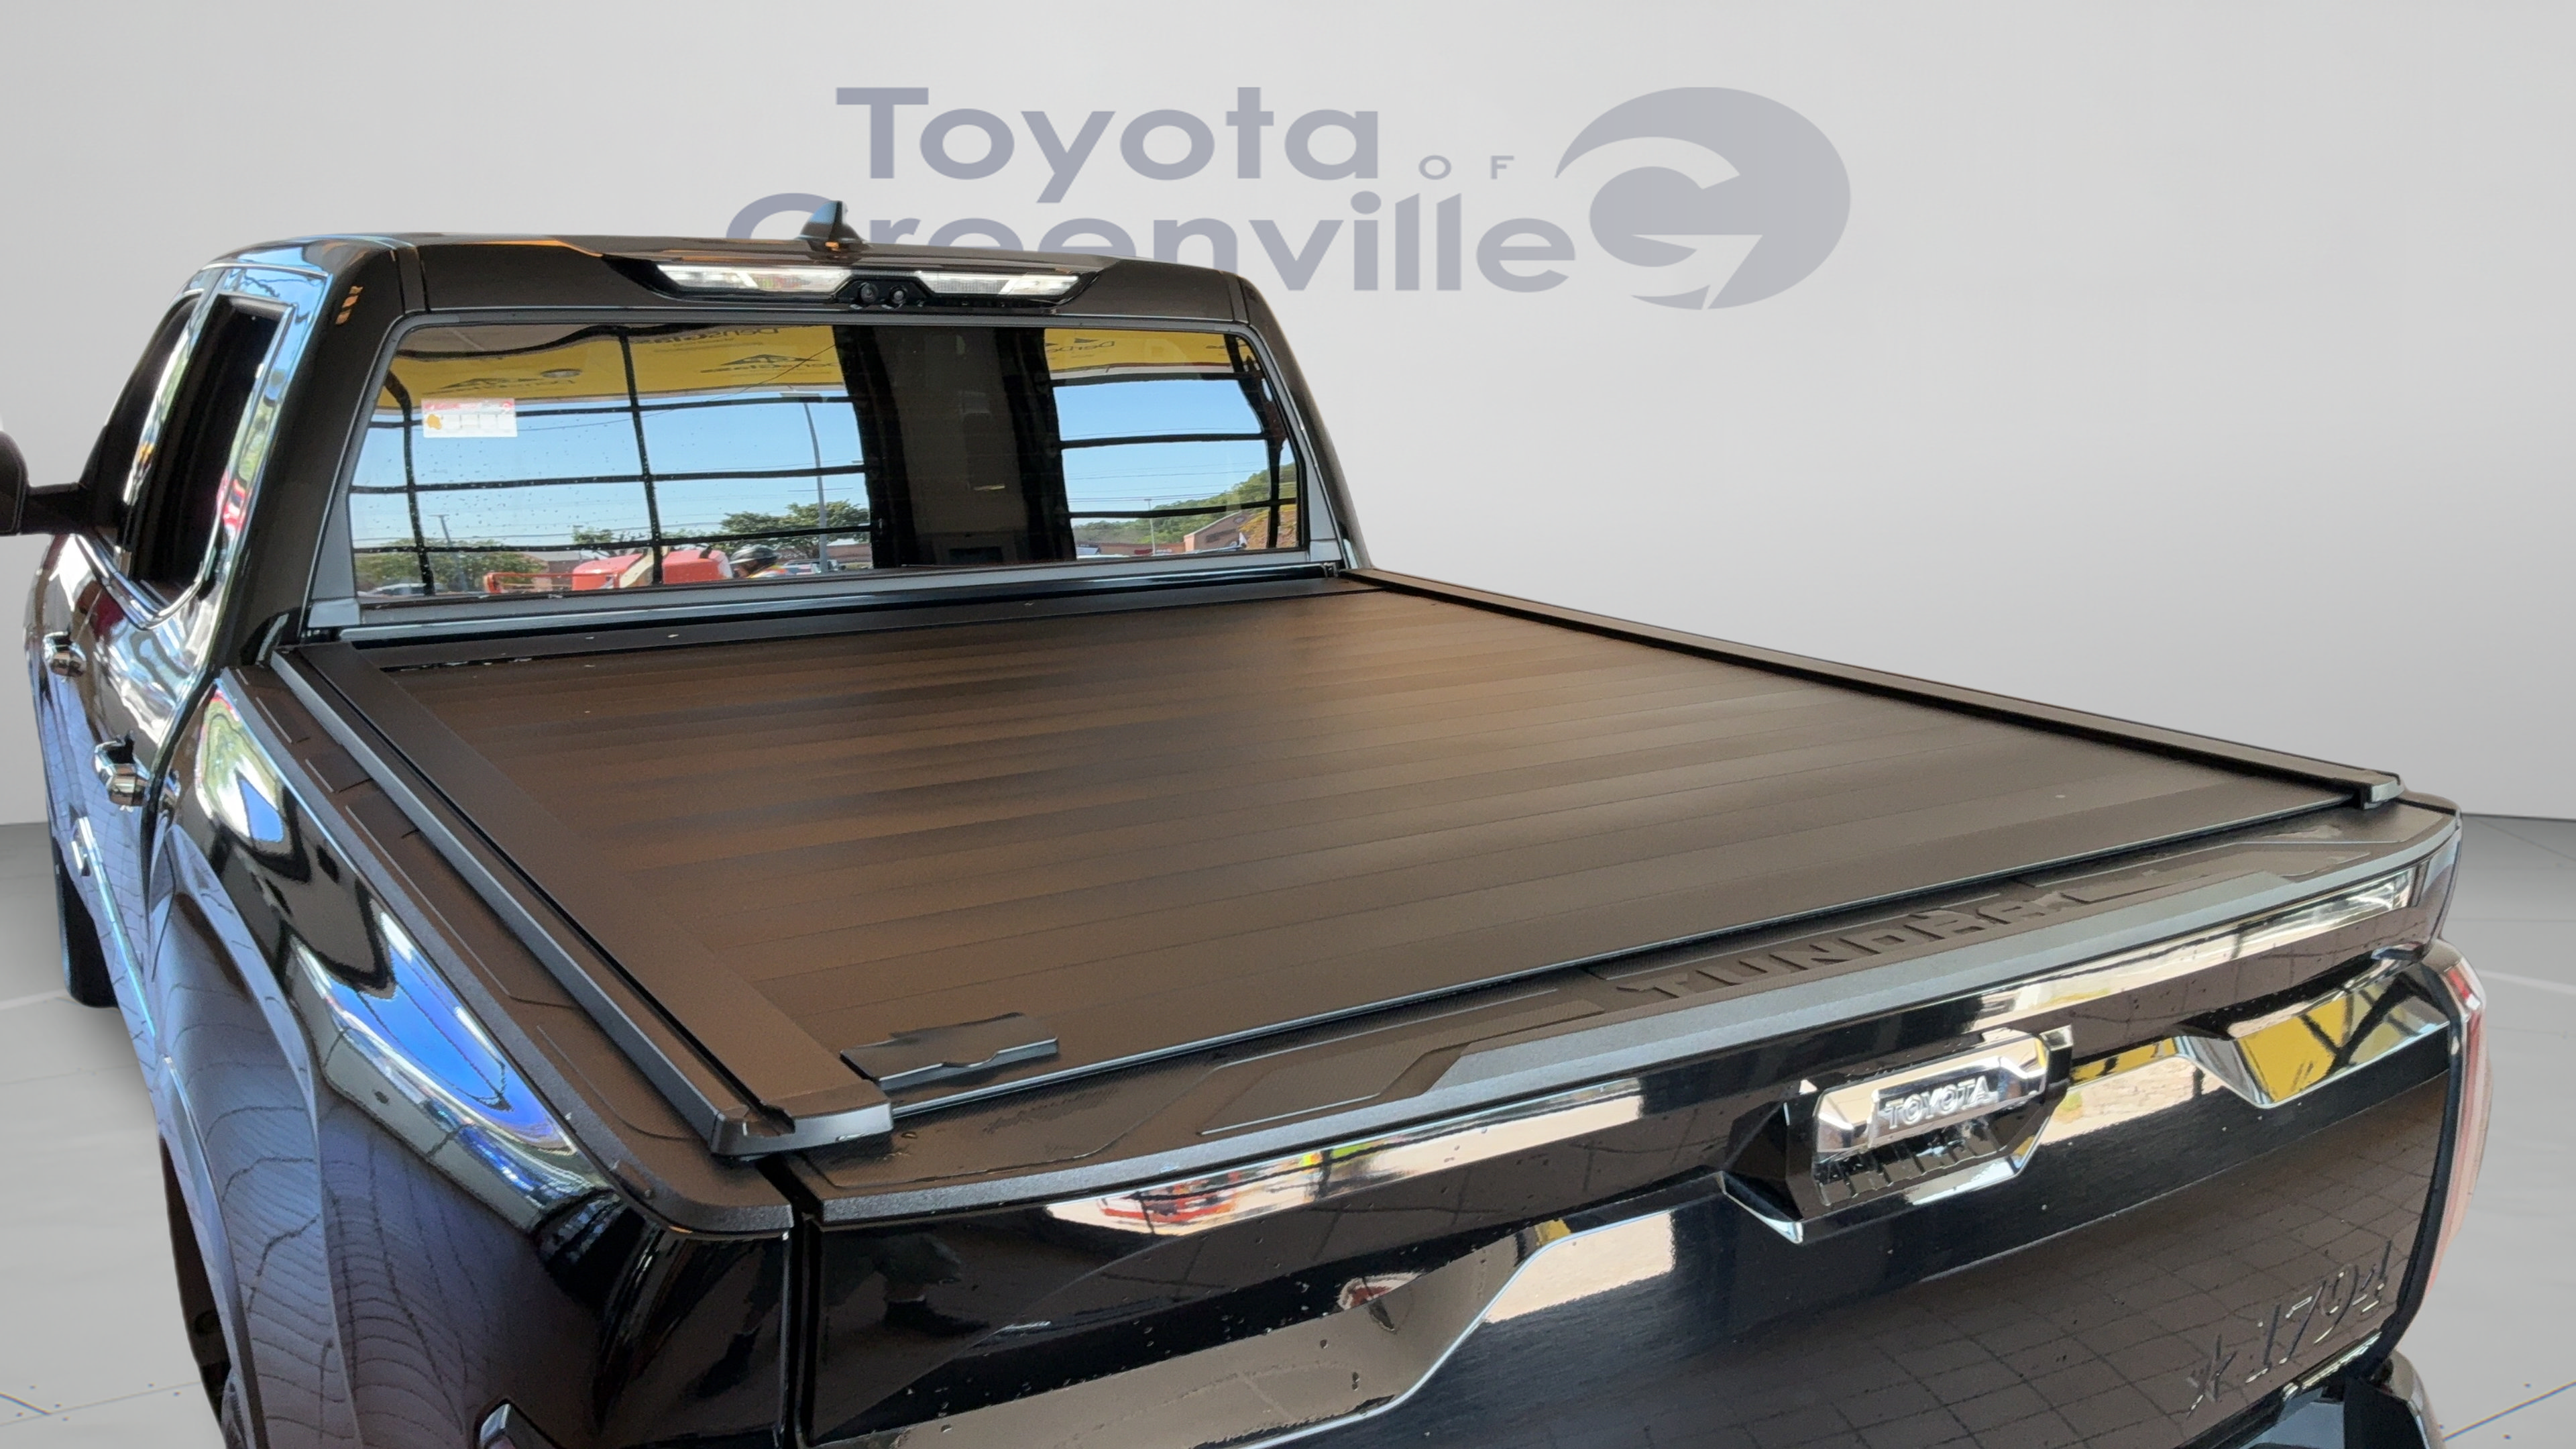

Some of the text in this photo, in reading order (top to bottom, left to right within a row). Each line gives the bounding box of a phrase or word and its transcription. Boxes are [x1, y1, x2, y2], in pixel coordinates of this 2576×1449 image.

[837, 87, 1515, 203] Toyota OF
[1883, 1075, 1992, 1129] TOYOTA
[2245, 1240, 2392, 1384] 1794
